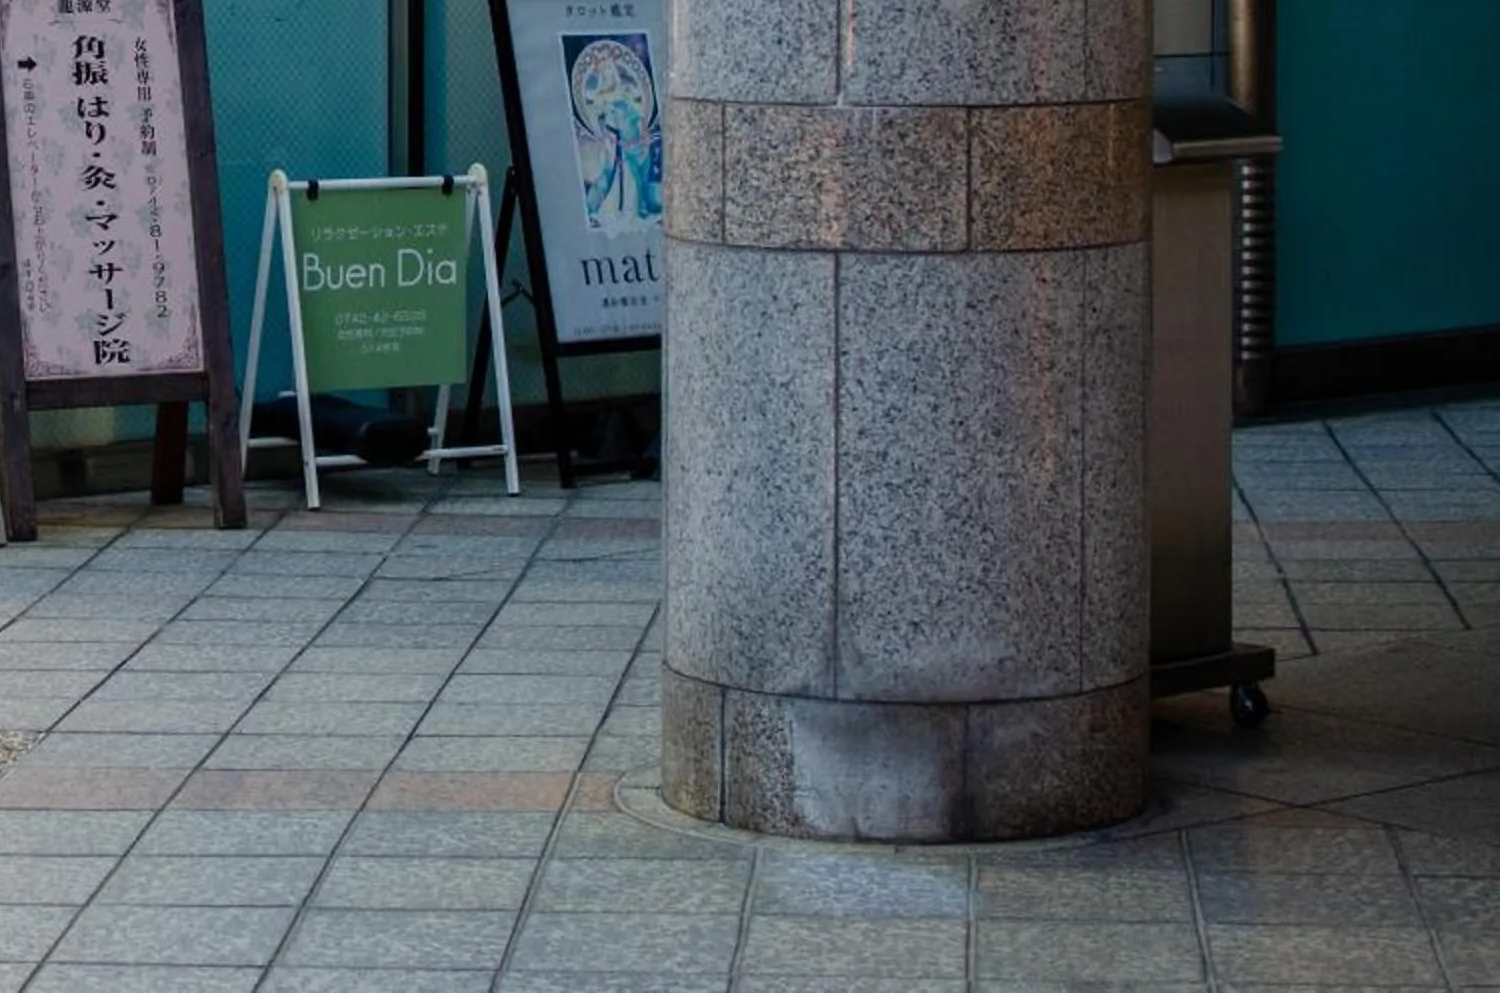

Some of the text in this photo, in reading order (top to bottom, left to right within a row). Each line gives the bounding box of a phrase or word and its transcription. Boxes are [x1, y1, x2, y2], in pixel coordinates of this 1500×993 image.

[72, 35, 131, 365] 角振 はり・灸・マッサージ院
[303, 252, 387, 292] Buen
